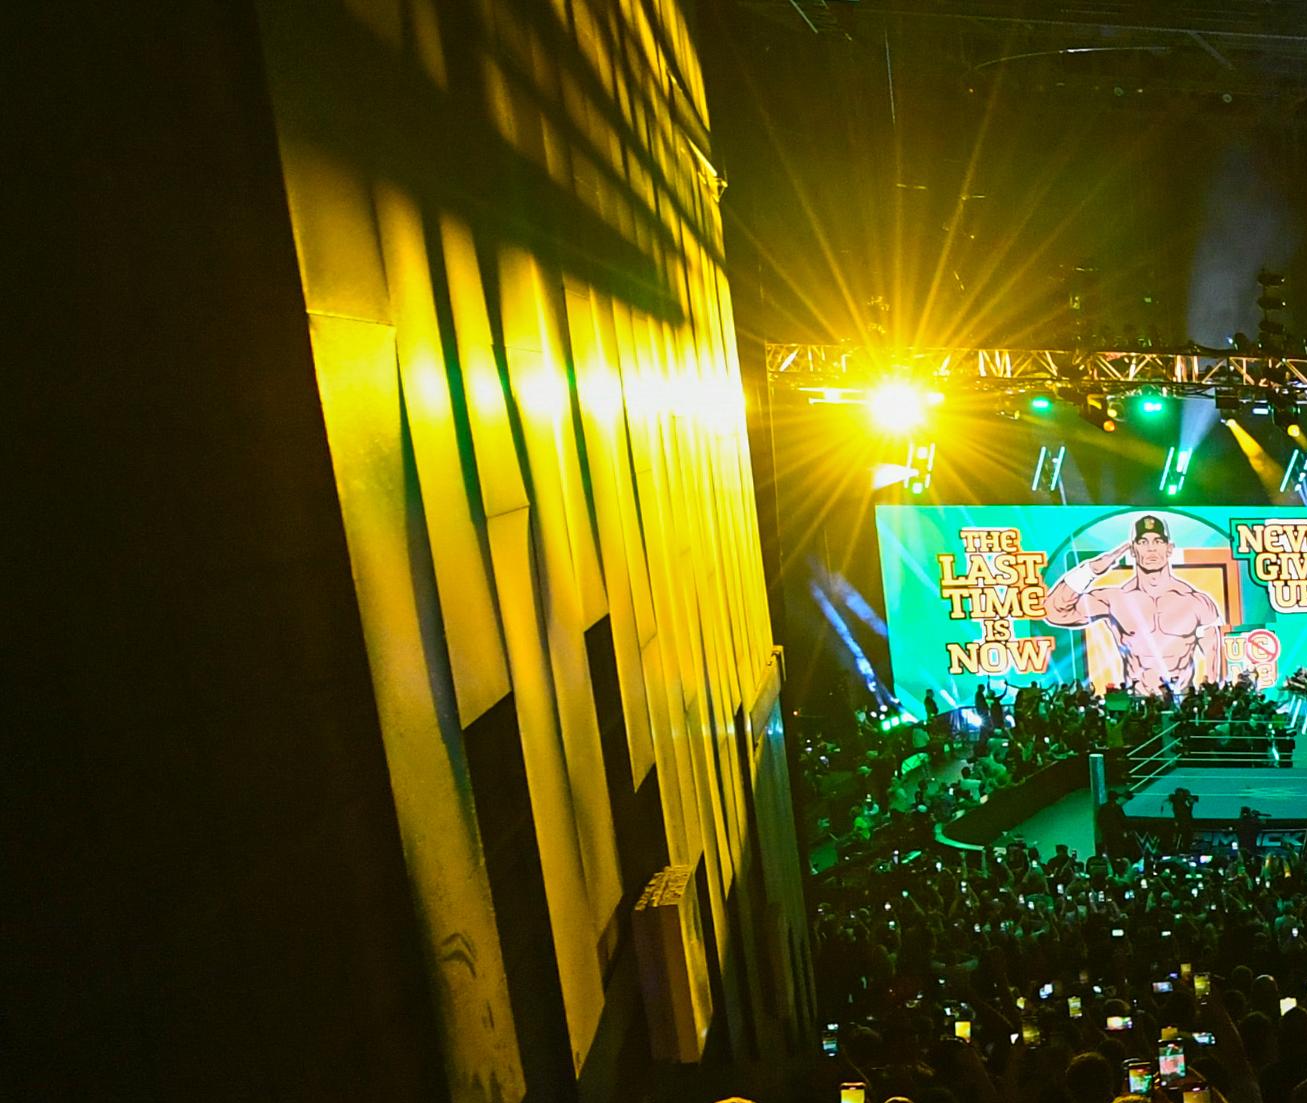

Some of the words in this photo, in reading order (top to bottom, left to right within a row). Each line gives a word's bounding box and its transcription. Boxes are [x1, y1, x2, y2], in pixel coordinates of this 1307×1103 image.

[960, 530, 1017, 552] THE
[938, 554, 1044, 586] LAST
[942, 586, 1048, 618] TIME
[984, 620, 1011, 641] IS
[946, 640, 1051, 674] NOW
